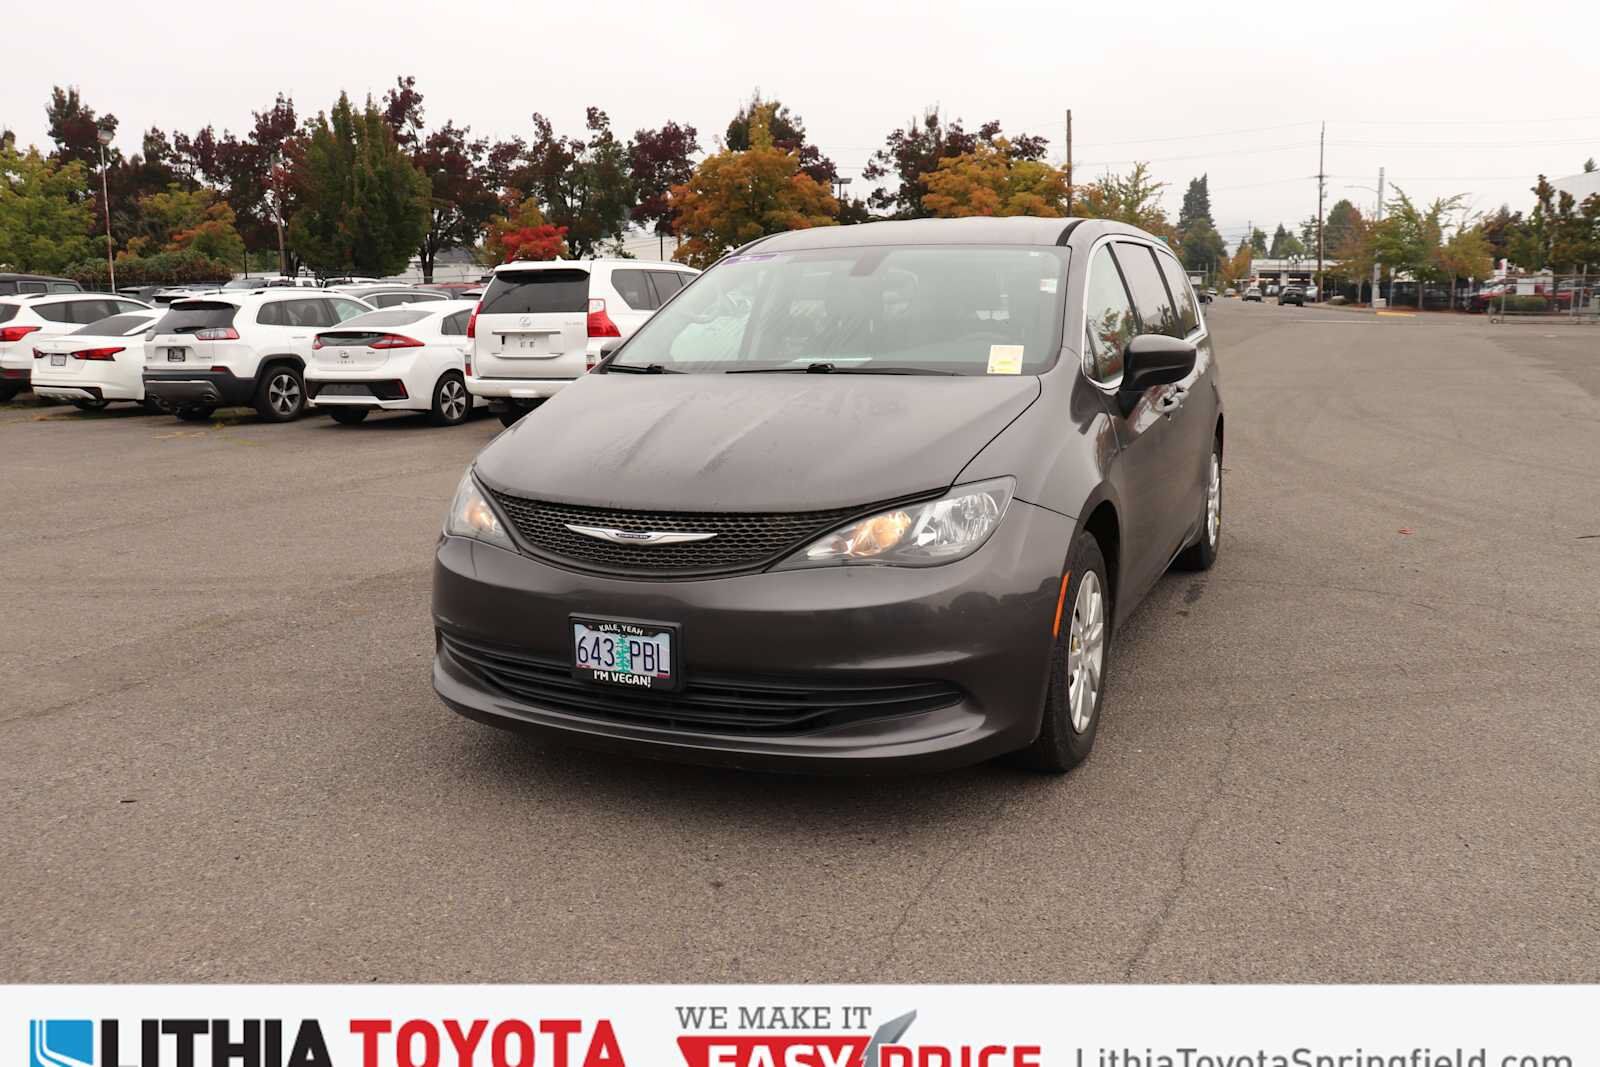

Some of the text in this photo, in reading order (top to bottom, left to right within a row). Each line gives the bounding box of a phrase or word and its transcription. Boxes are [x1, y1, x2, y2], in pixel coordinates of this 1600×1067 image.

[599, 624, 643, 635] KALE, YEAH
[578, 636, 668, 674] 643 PBL
[594, 670, 609, 681] I'M
[611, 672, 651, 688] VEGAN!
